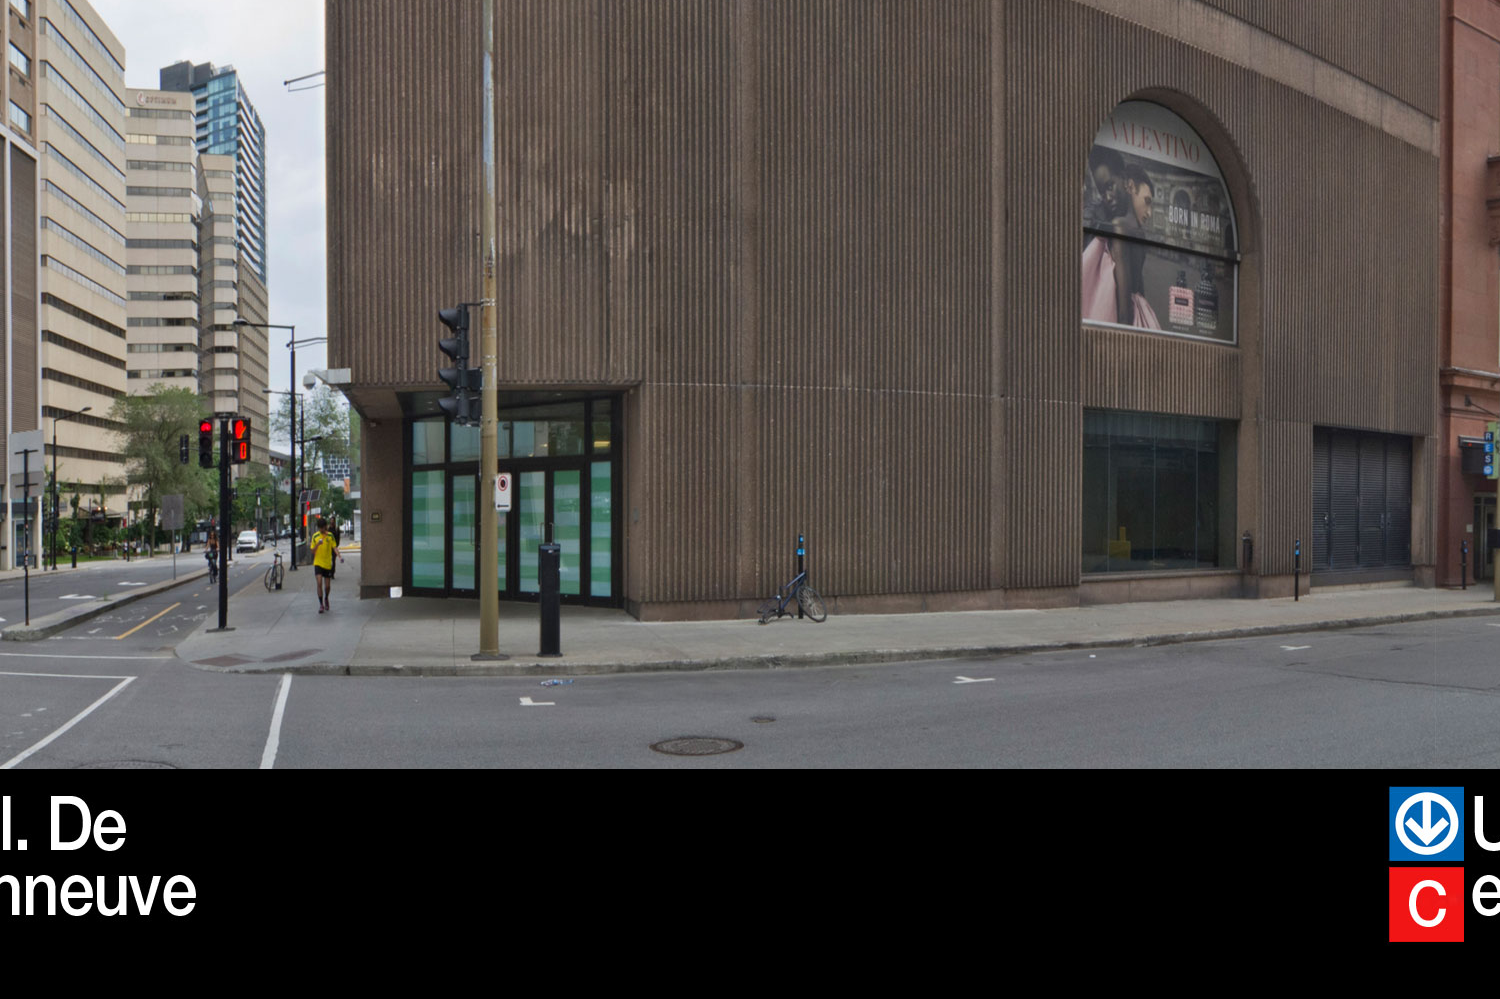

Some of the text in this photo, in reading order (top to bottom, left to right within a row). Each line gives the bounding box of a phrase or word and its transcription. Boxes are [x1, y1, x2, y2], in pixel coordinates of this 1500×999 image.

[1110, 117, 1200, 163] VALENTINO
[1168, 205, 1220, 234] BORN IN ROMA
